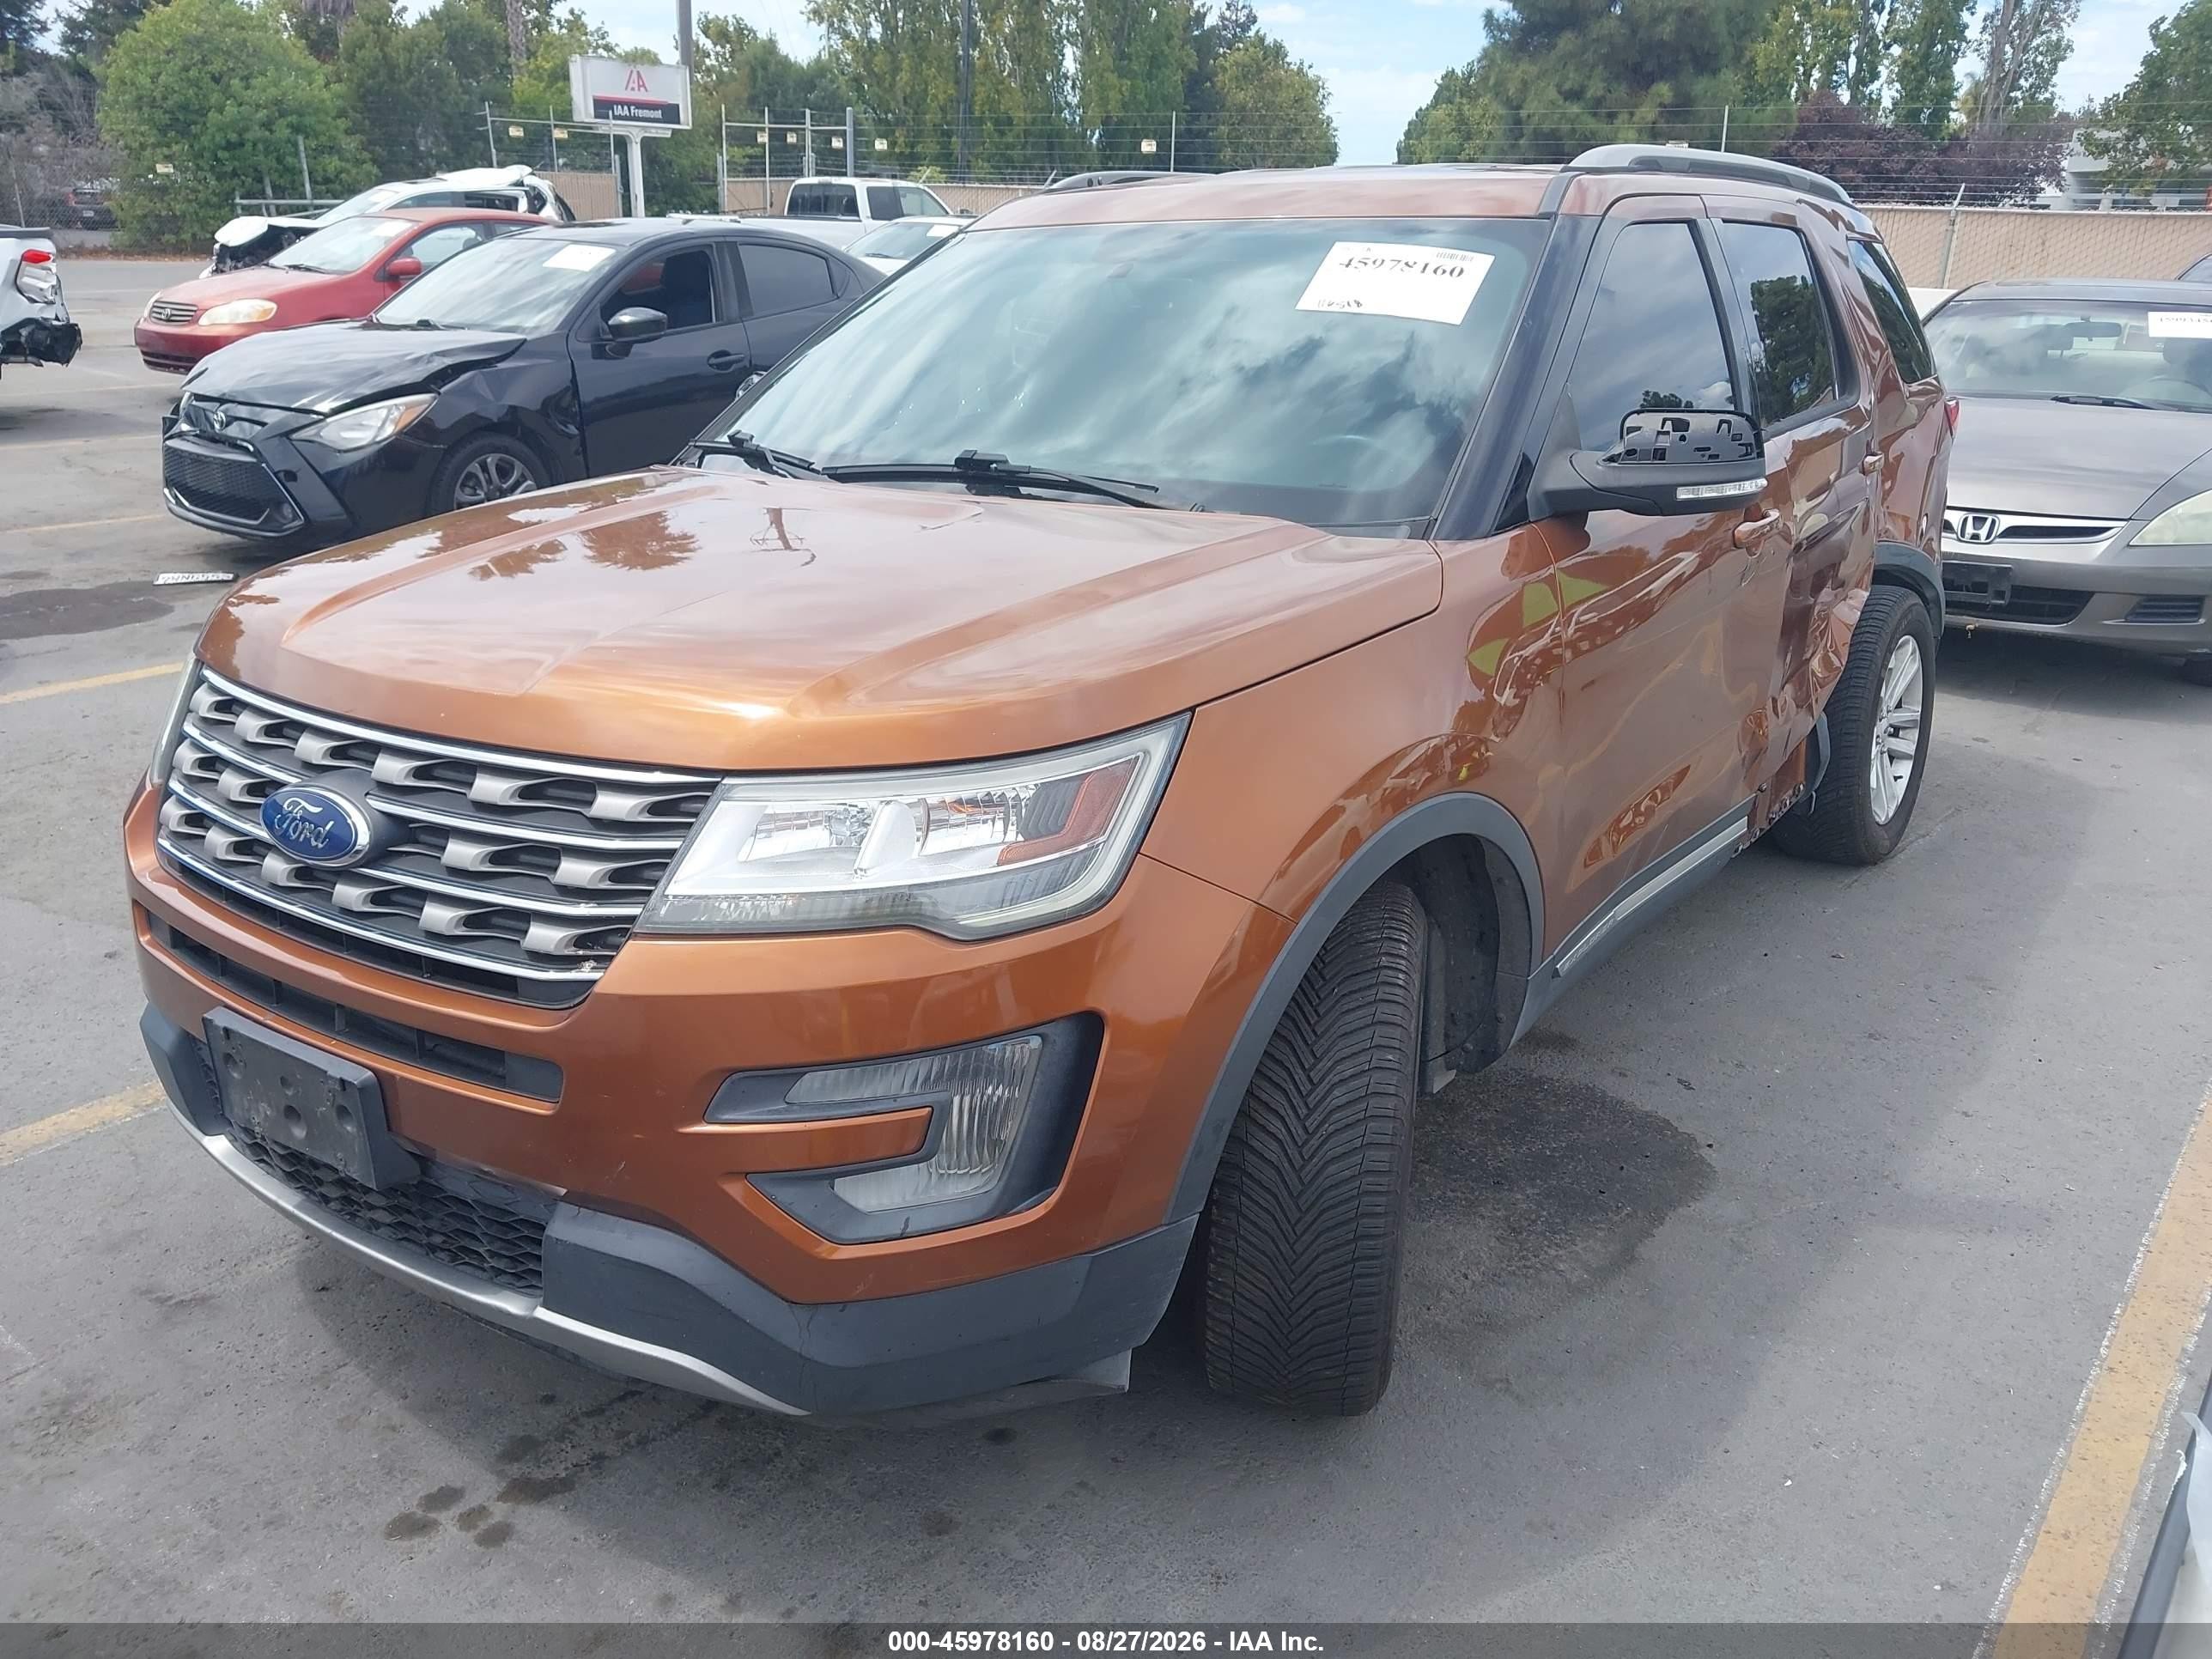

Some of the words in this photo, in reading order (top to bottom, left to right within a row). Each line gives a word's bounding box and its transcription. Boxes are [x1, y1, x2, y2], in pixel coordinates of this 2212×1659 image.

[613, 105, 629, 117] IAA
[630, 106, 663, 119] Fremont
[1339, 256, 1465, 279] 45978160
[274, 797, 335, 849] Ford
